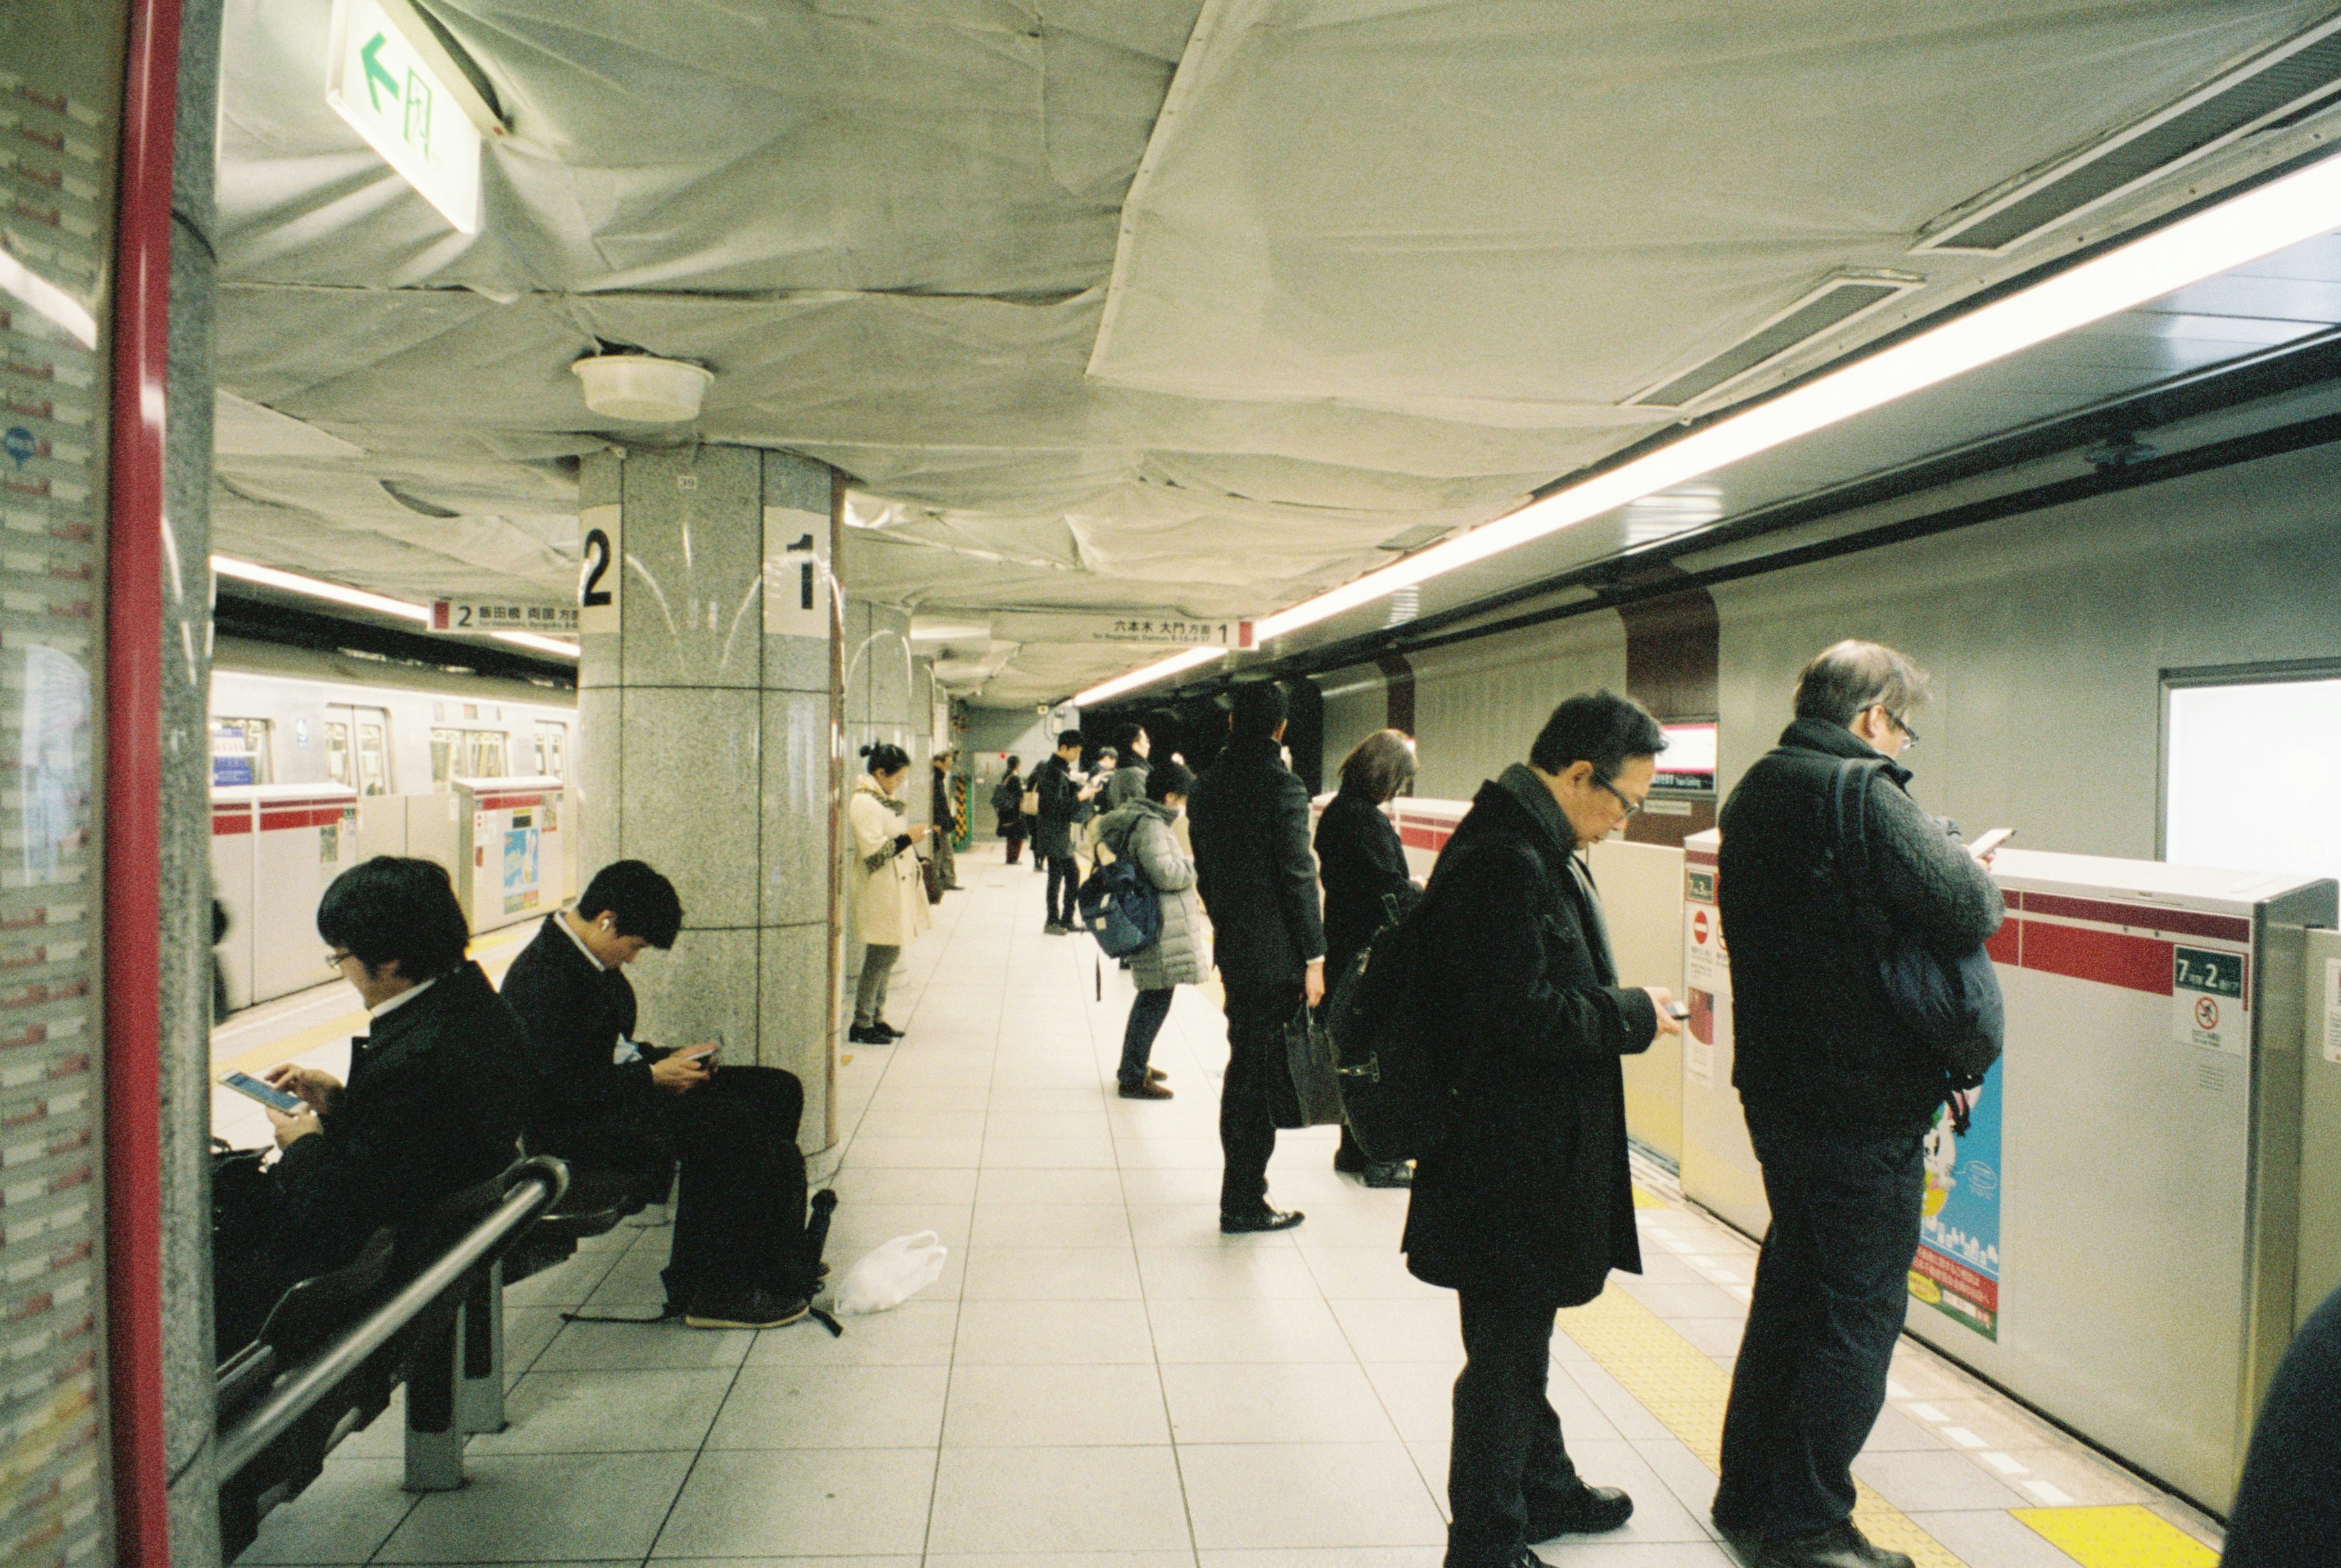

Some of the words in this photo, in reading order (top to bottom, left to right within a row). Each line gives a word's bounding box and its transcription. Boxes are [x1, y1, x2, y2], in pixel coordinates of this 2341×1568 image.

[679, 478, 695, 488] 39
[584, 529, 612, 607] 2
[786, 533, 813, 609] 1
[457, 605, 472, 627] 2
[1114, 619, 1153, 633] 六本木
[1160, 621, 1185, 635] 大門
[1189, 623, 1210, 635] 方面
[1218, 623, 1227, 644] 1
